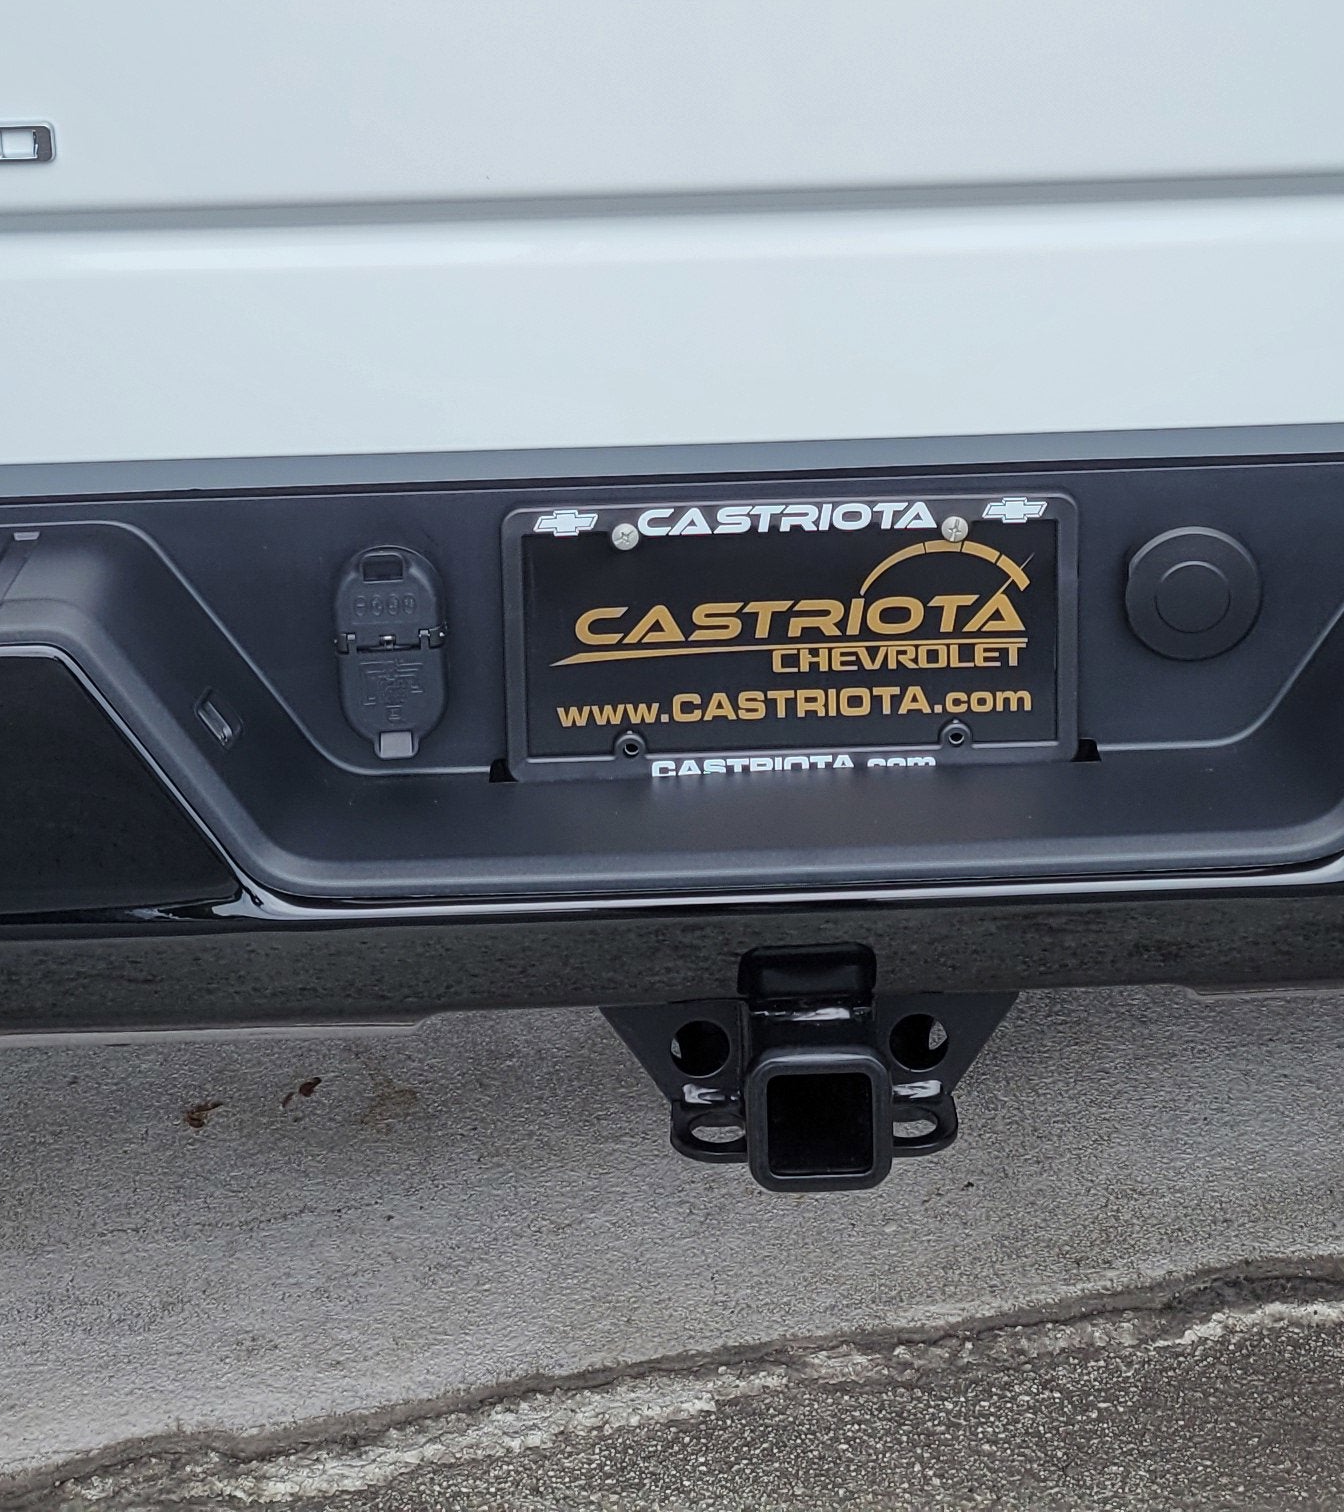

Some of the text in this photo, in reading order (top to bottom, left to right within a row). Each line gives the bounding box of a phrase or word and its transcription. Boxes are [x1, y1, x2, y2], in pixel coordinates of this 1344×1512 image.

[637, 501, 938, 538] CASTRIOTA
[574, 593, 1026, 644] CASTRIOTA
[771, 643, 1026, 674] CHEVROLET
[556, 685, 1033, 728] www.CASTRIOTA.com
